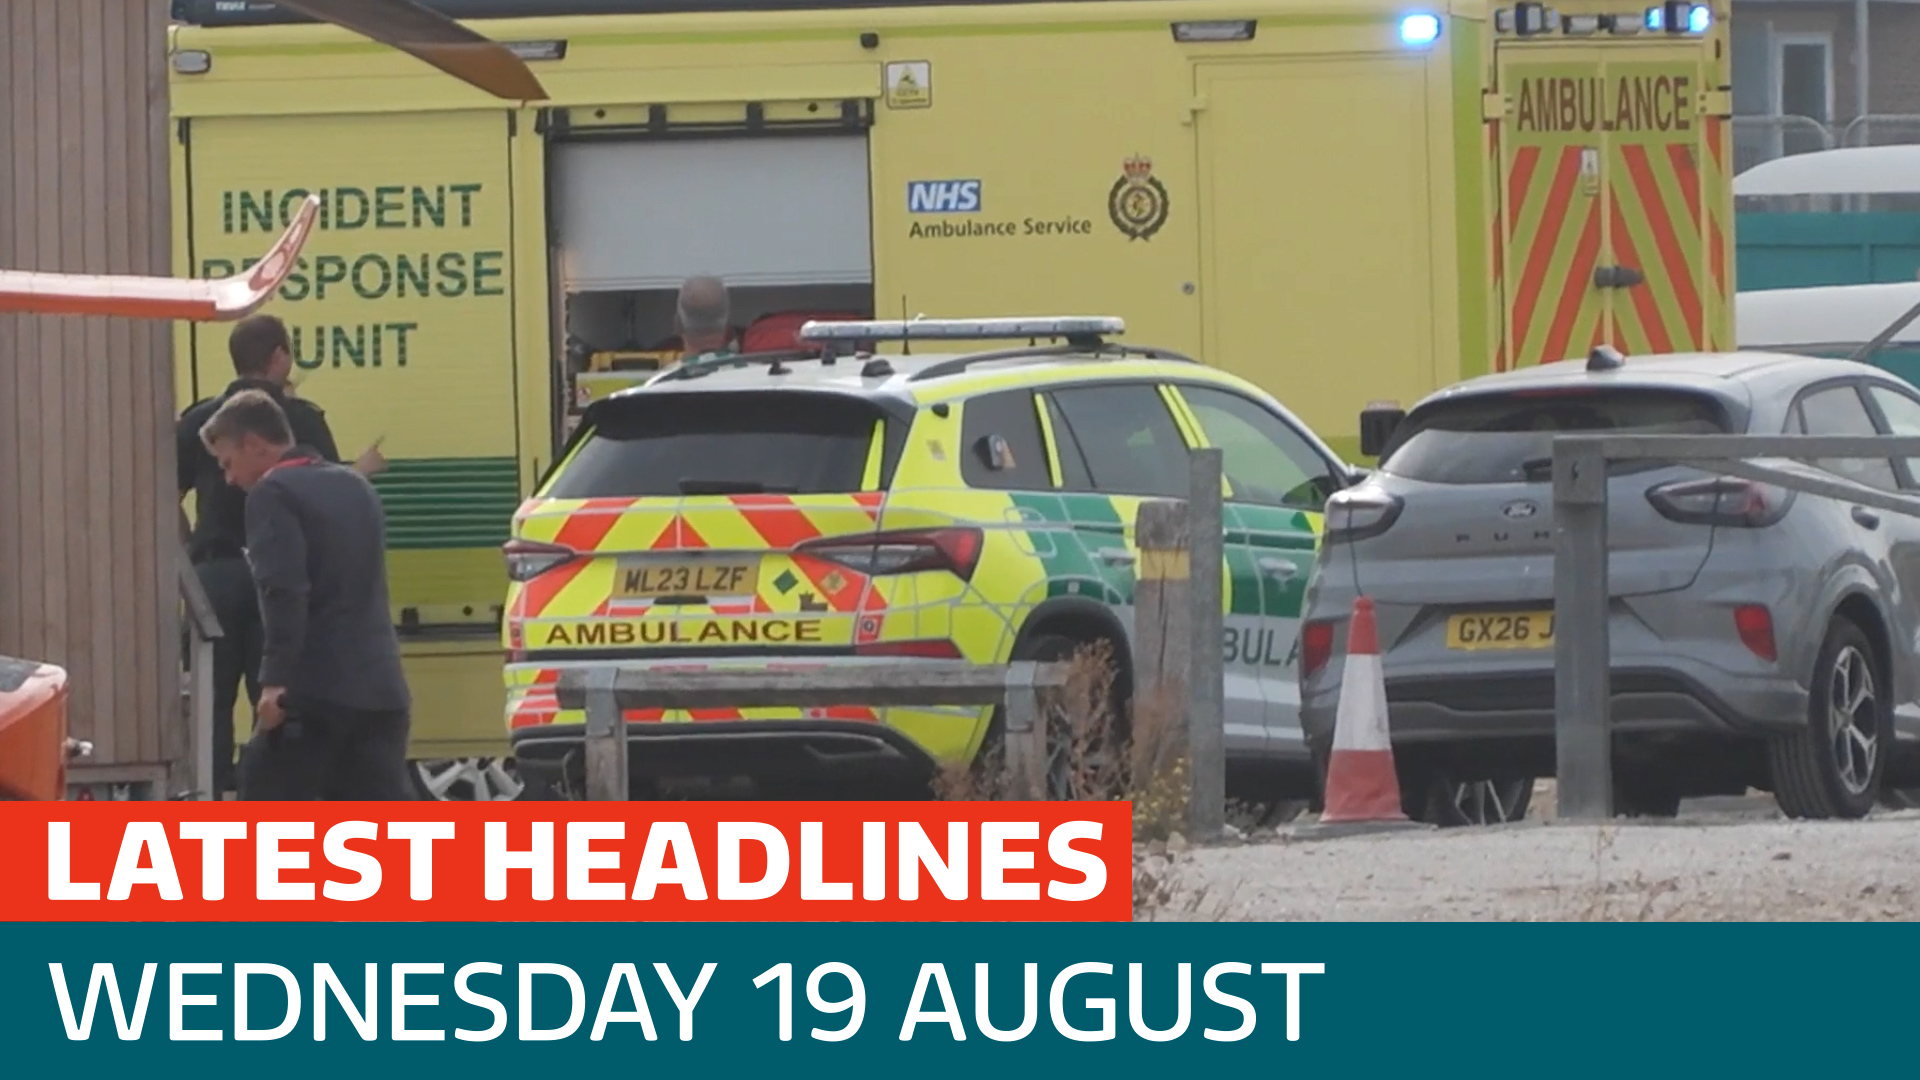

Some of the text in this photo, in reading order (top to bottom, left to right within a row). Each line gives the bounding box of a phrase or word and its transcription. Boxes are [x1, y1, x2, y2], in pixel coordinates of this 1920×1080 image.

[1518, 75, 1690, 132] AMBULANCE
[223, 183, 482, 233] INCIDENT
[911, 181, 979, 210] NHS
[909, 216, 1092, 239] Ambulance Service
[202, 251, 504, 301] SPONSE
[292, 322, 418, 369] UNIT
[1456, 531, 1550, 543] PUM
[696, 566, 748, 591] LZF
[546, 619, 822, 645] AMBULANCE
[1459, 613, 1555, 643] GX26 J
[1223, 627, 1299, 668] BULA
